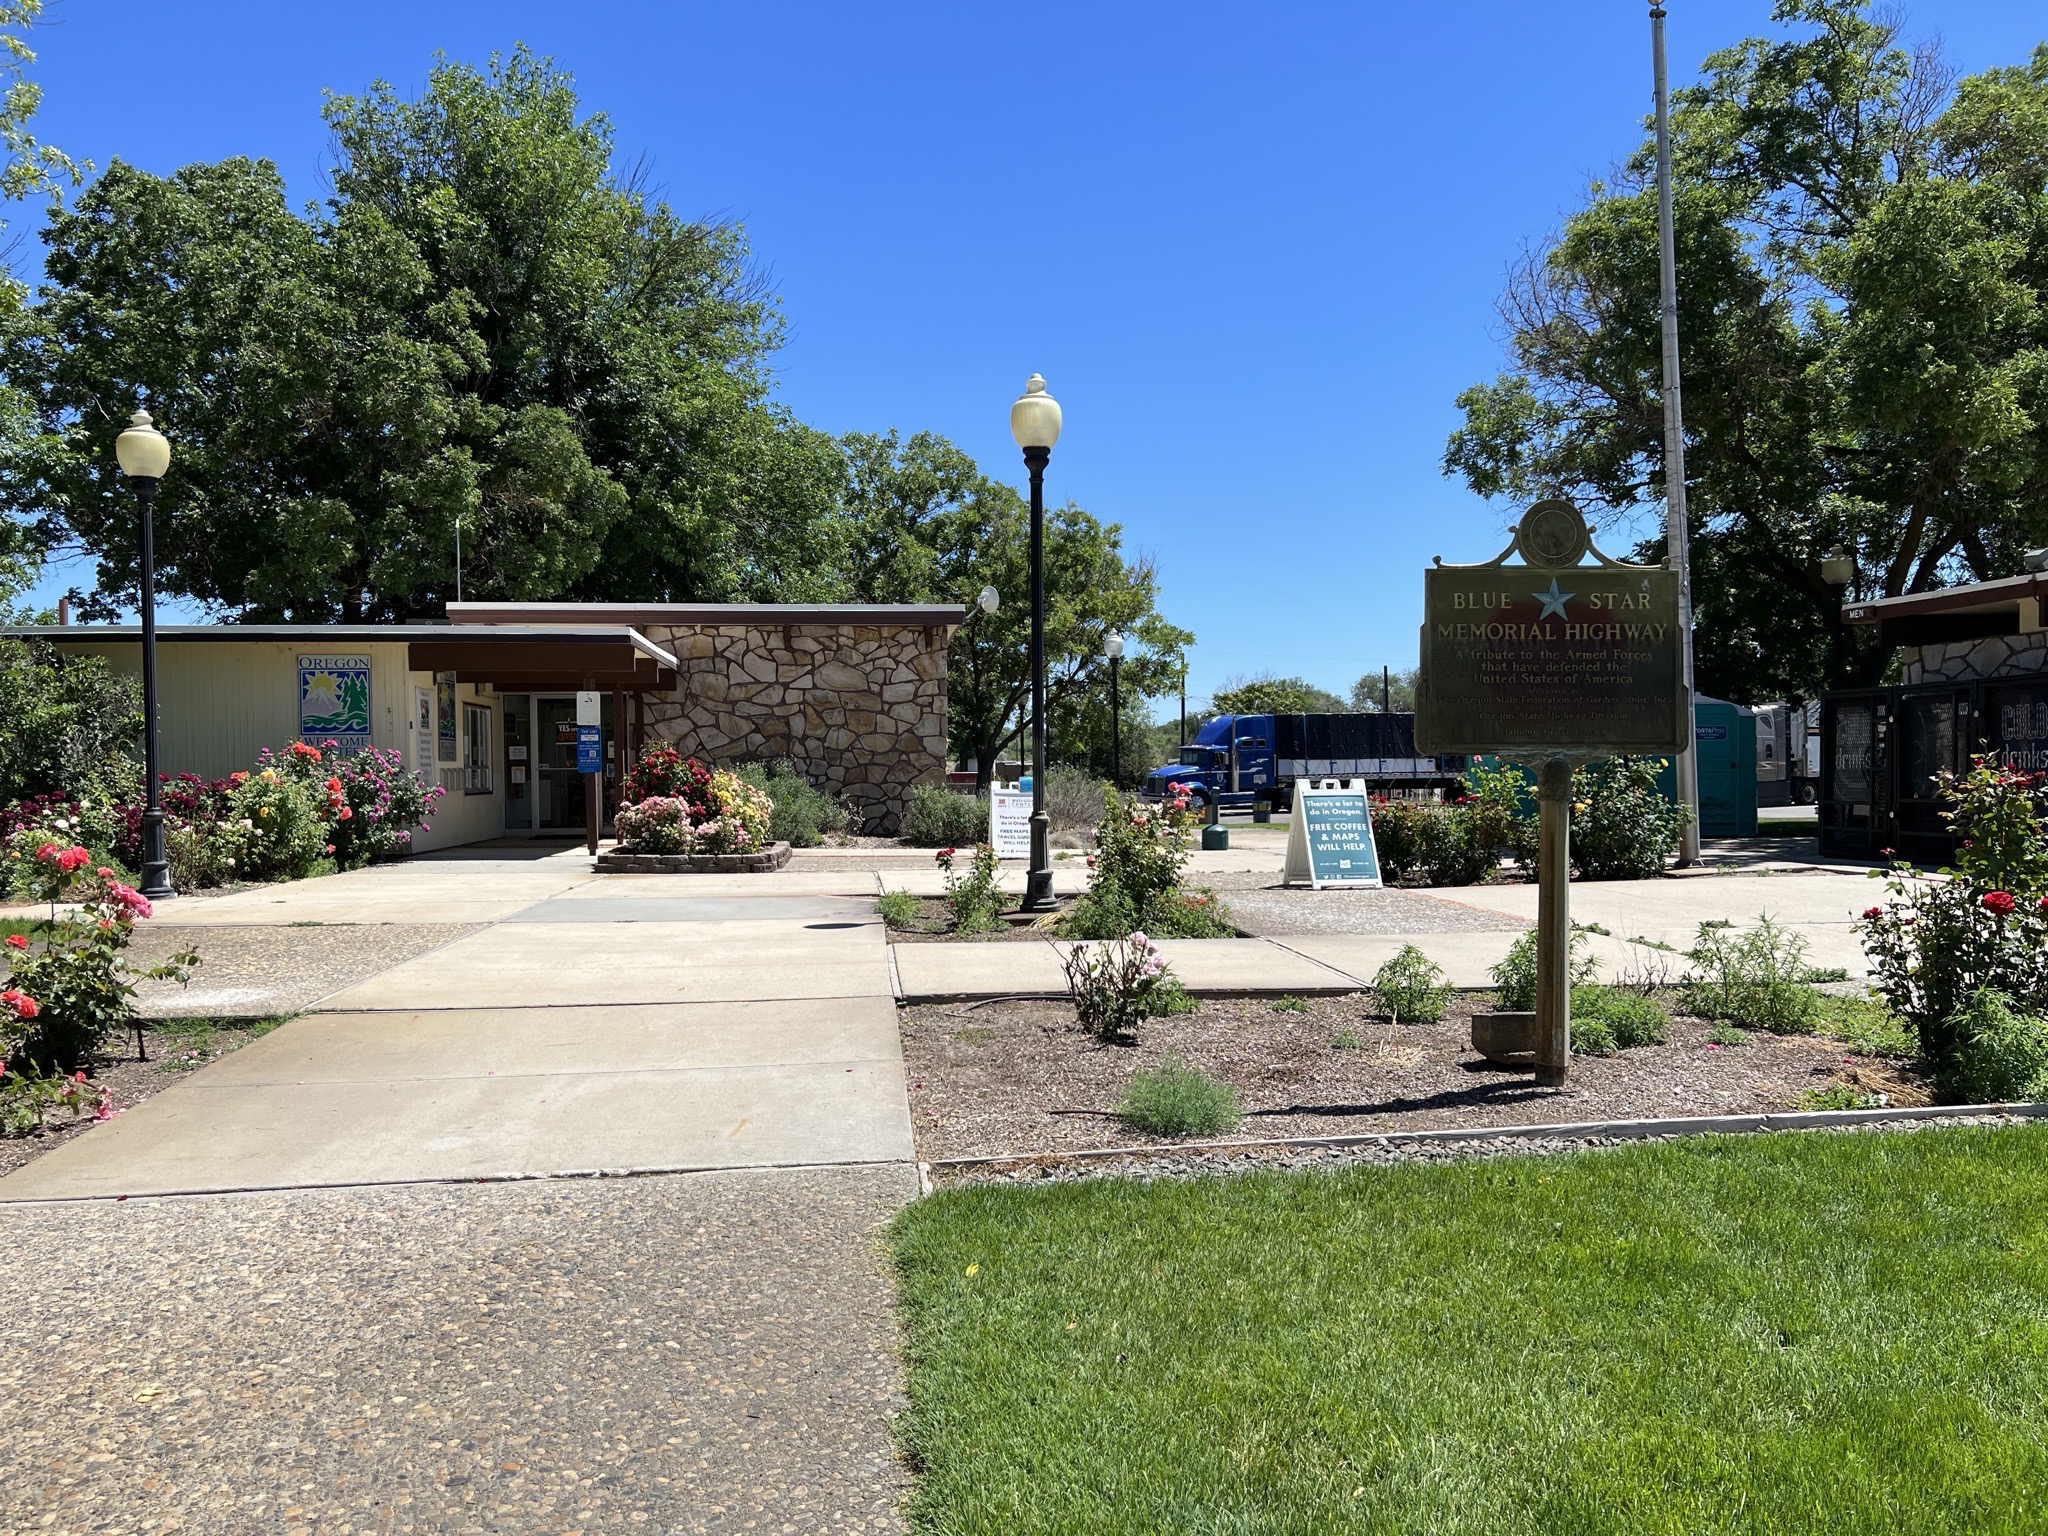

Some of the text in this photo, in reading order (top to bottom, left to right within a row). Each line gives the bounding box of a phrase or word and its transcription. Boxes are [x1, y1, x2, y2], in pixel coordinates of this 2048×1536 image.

[1453, 592, 1651, 609] BLUE STAR
[1849, 609, 1864, 619] MEN
[1437, 623, 1668, 640] MEMORIAL HIGHWAY
[1455, 649, 1653, 660] A tribute to the Armed Forces
[299, 657, 369, 668] OREGON
[1481, 661, 1627, 672] that have defended the
[1474, 673, 1633, 684] United States of America
[1457, 696, 1492, 705] Oregon
[1496, 696, 1519, 704] State
[1521, 696, 1570, 704] Federation
[1573, 696, 1583, 704] of
[1586, 695, 1619, 704] Garden
[1479, 712, 1514, 721] Oregon
[1519, 712, 1543, 720] State
[2001, 702, 2048, 740] COLD
[558, 724, 570, 732] YES
[557, 732, 576, 742] OPE
[1835, 747, 1871, 769] drinks
[2001, 742, 2048, 769] drinks
[1331, 808, 1363, 816] Oregon.
[1310, 823, 1367, 831] FREE COFFEE
[1321, 833, 1360, 841] & MAPS
[1316, 843, 1367, 851] WILL HELP.
